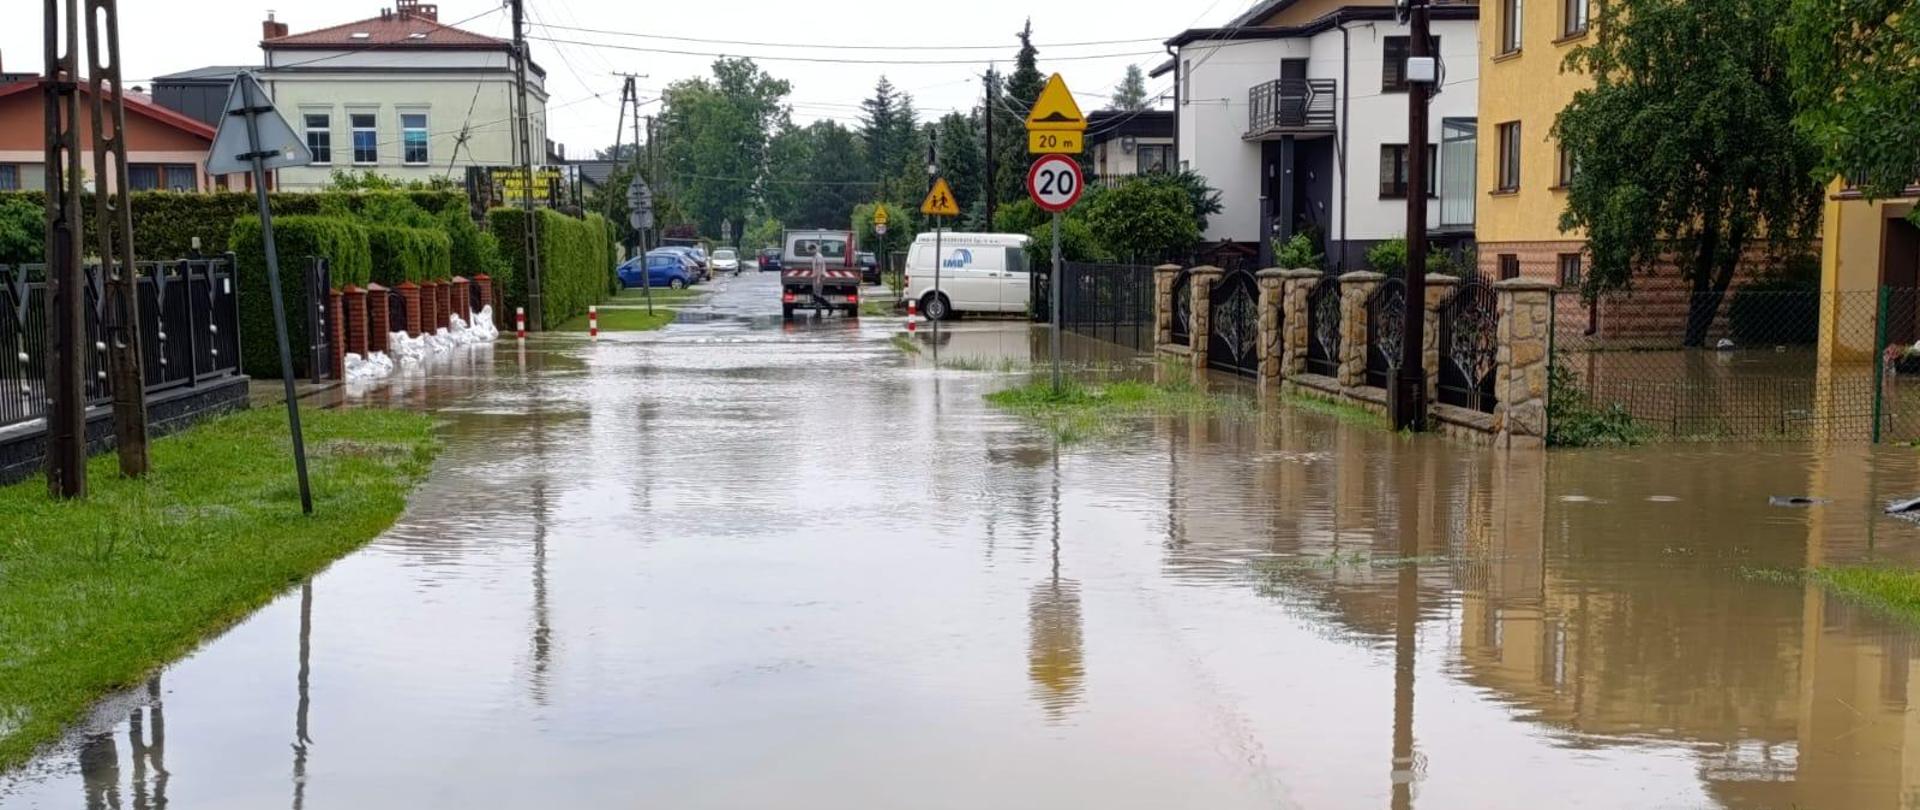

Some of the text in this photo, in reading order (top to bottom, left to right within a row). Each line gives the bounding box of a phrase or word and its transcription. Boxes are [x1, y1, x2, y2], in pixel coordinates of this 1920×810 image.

[1039, 135, 1073, 148] 20 m
[1039, 169, 1074, 195] 20
